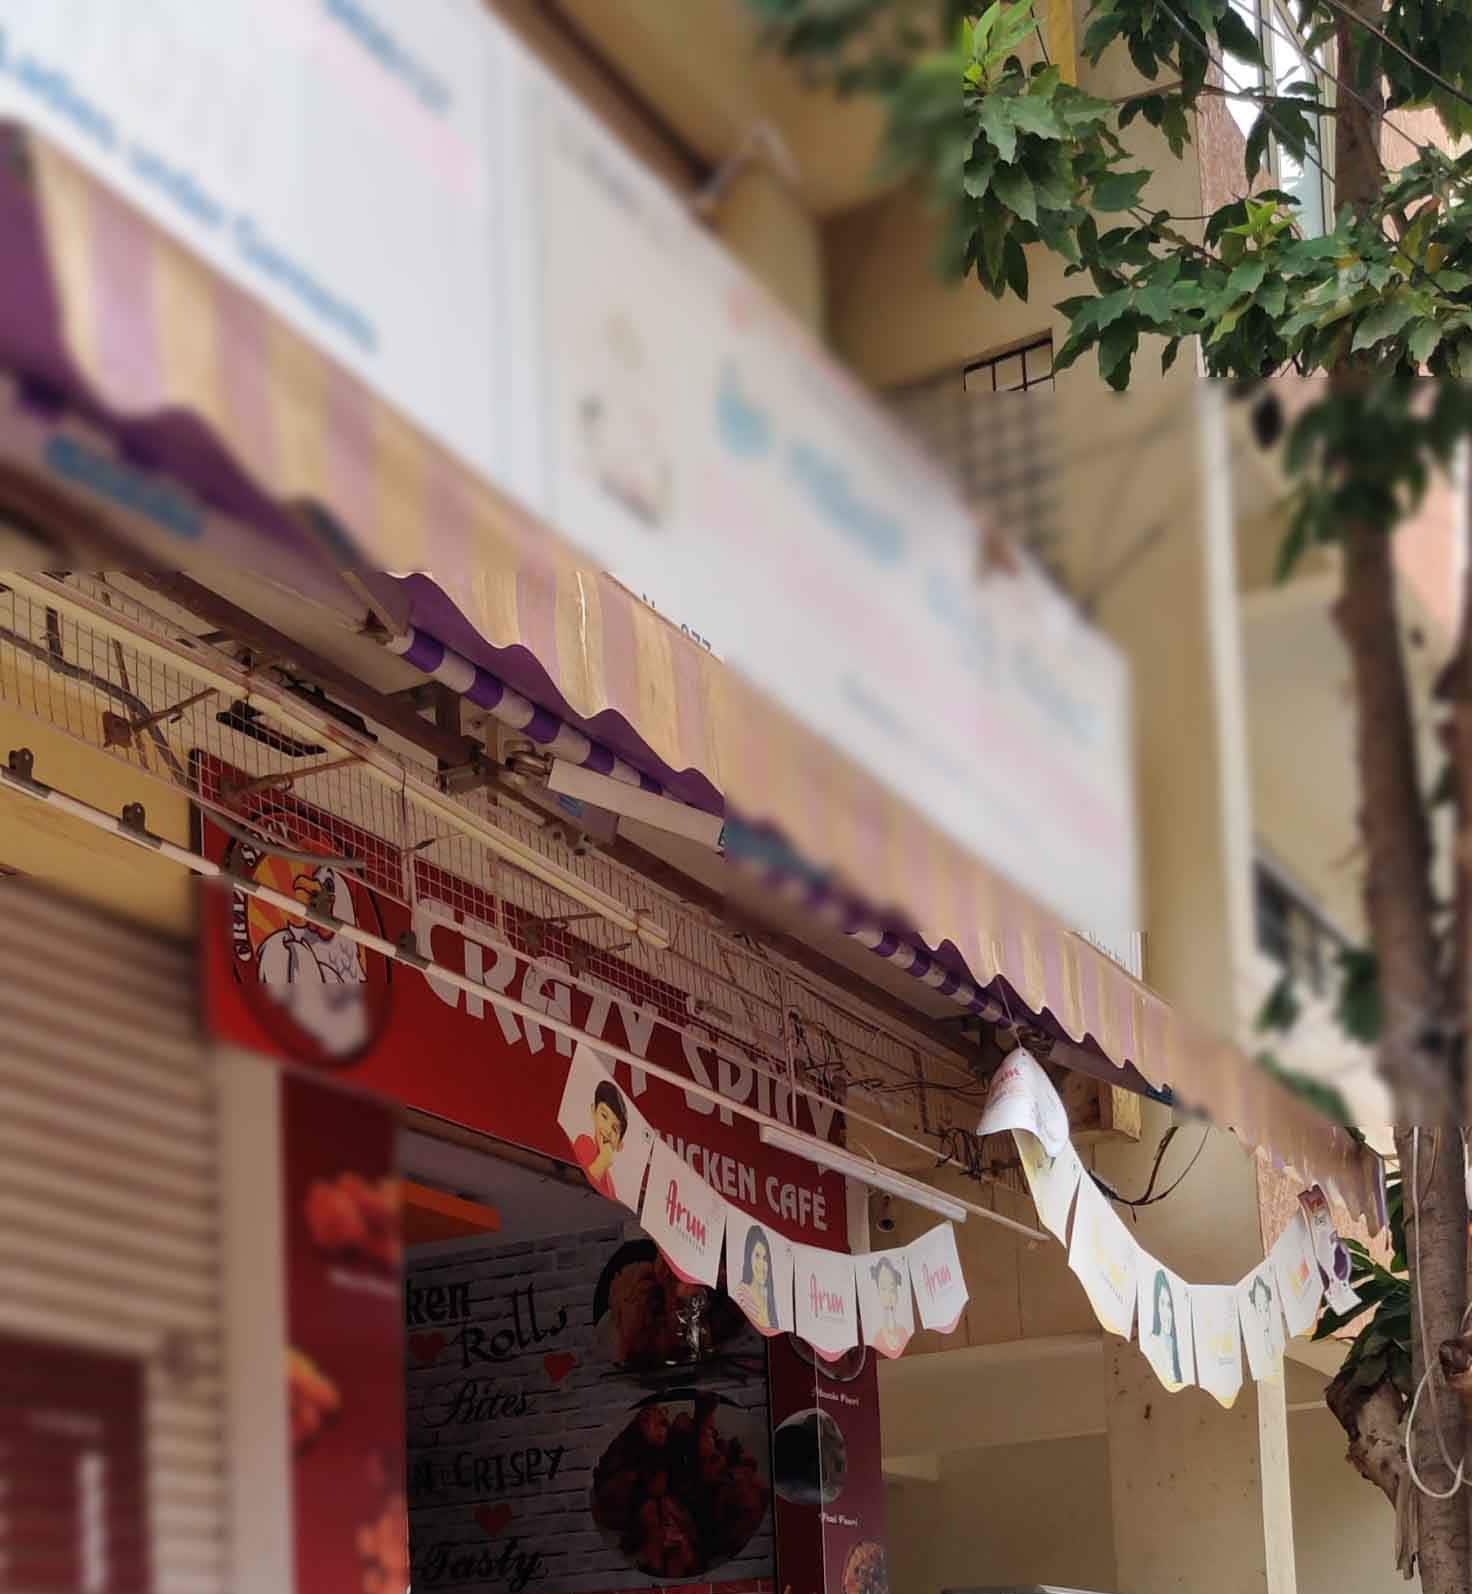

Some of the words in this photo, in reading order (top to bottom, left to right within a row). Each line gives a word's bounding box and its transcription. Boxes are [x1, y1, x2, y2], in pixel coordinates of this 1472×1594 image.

[666, 1179, 706, 1248] Arun
[765, 1176, 828, 1232] CAFÉ
[809, 1272, 845, 1318] Arun
[457, 1444, 564, 1491] CRISPY
